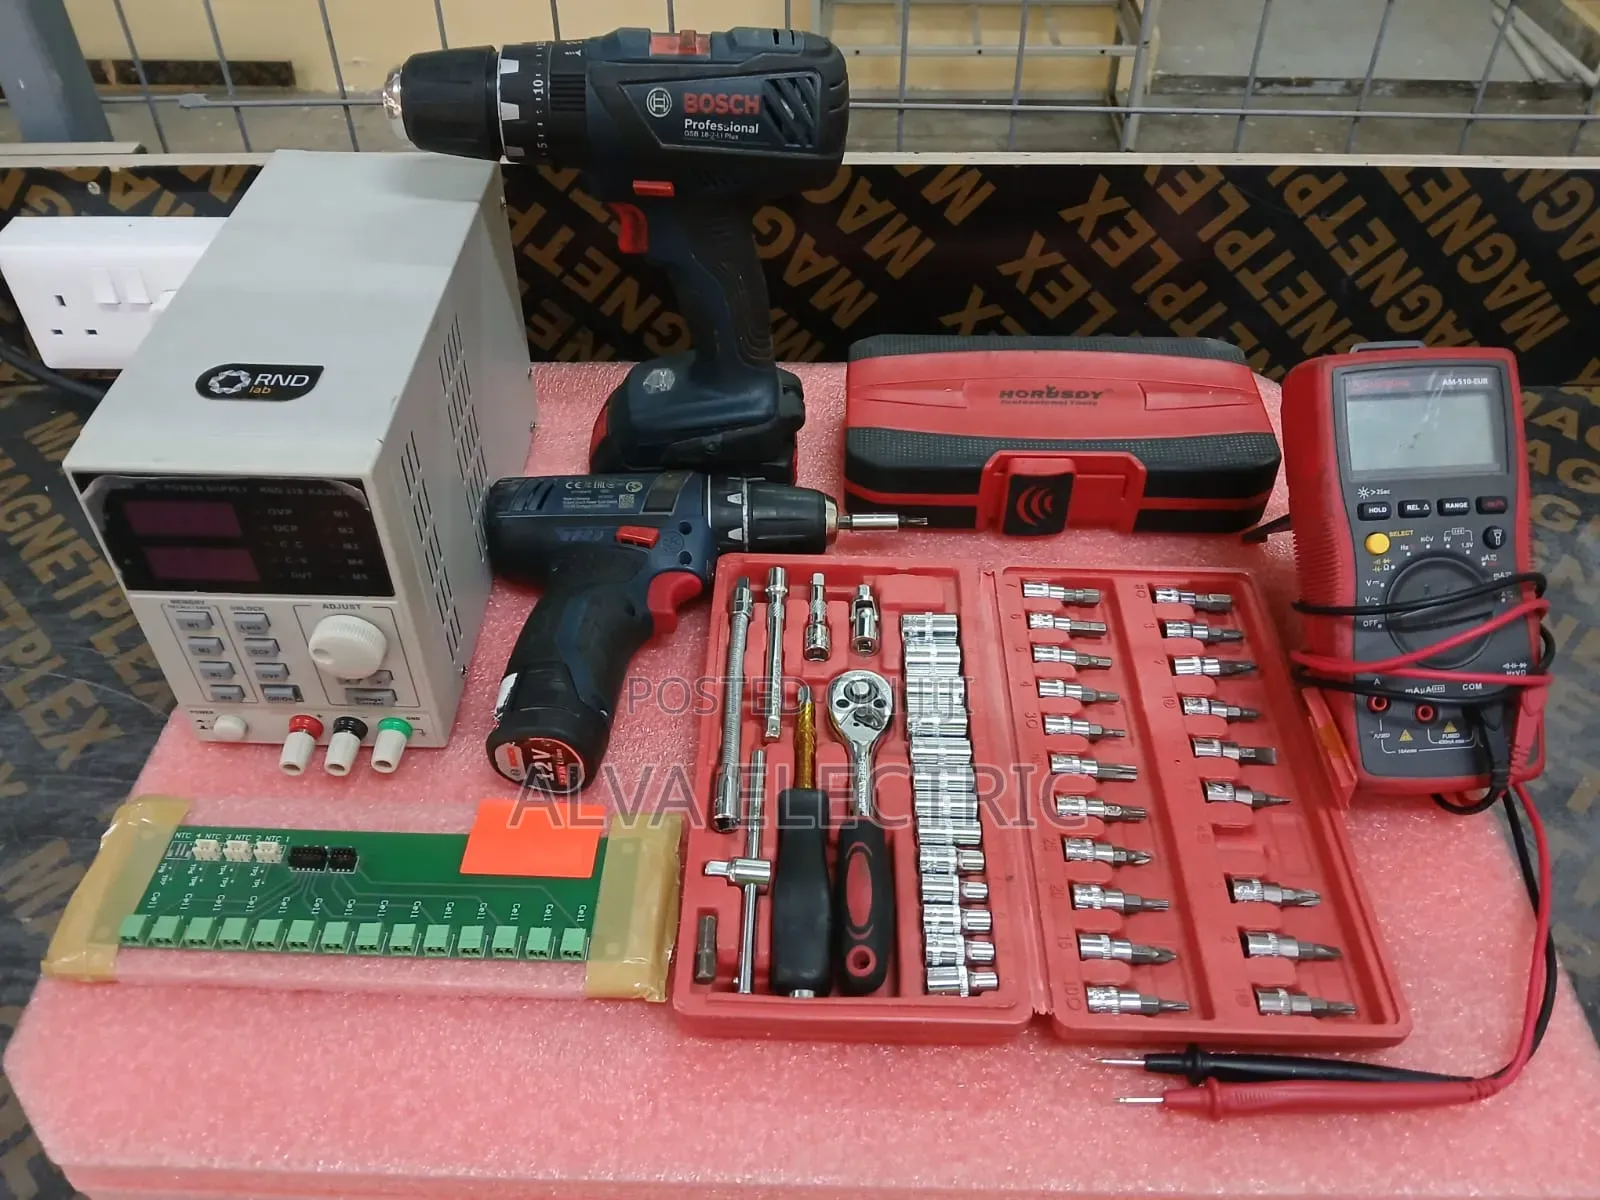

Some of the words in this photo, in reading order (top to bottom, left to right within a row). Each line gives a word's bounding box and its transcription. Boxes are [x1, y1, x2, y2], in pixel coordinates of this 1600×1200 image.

[683, 93, 760, 114] BOSCH
[684, 118, 759, 134] Professional
[254, 374, 309, 386] RND
[249, 386, 271, 394] lab
[1389, 530, 1414, 538] SELECT
[531, 748, 554, 781] 12V
[147, 892, 160, 909] Cell
[180, 893, 192, 910] Cell
[212, 894, 225, 911] Cell
[245, 895, 258, 912] Cell
[278, 896, 290, 914] Cell
[311, 898, 323, 914] Cell
[344, 899, 356, 916] Cell
[377, 900, 389, 916] Cell
[410, 900, 422, 918] Cell
[443, 901, 455, 919] Cell
[477, 902, 488, 920] Cell
[510, 903, 520, 920] Cell
[543, 904, 554, 921] Cell
[577, 904, 587, 922] Cell
